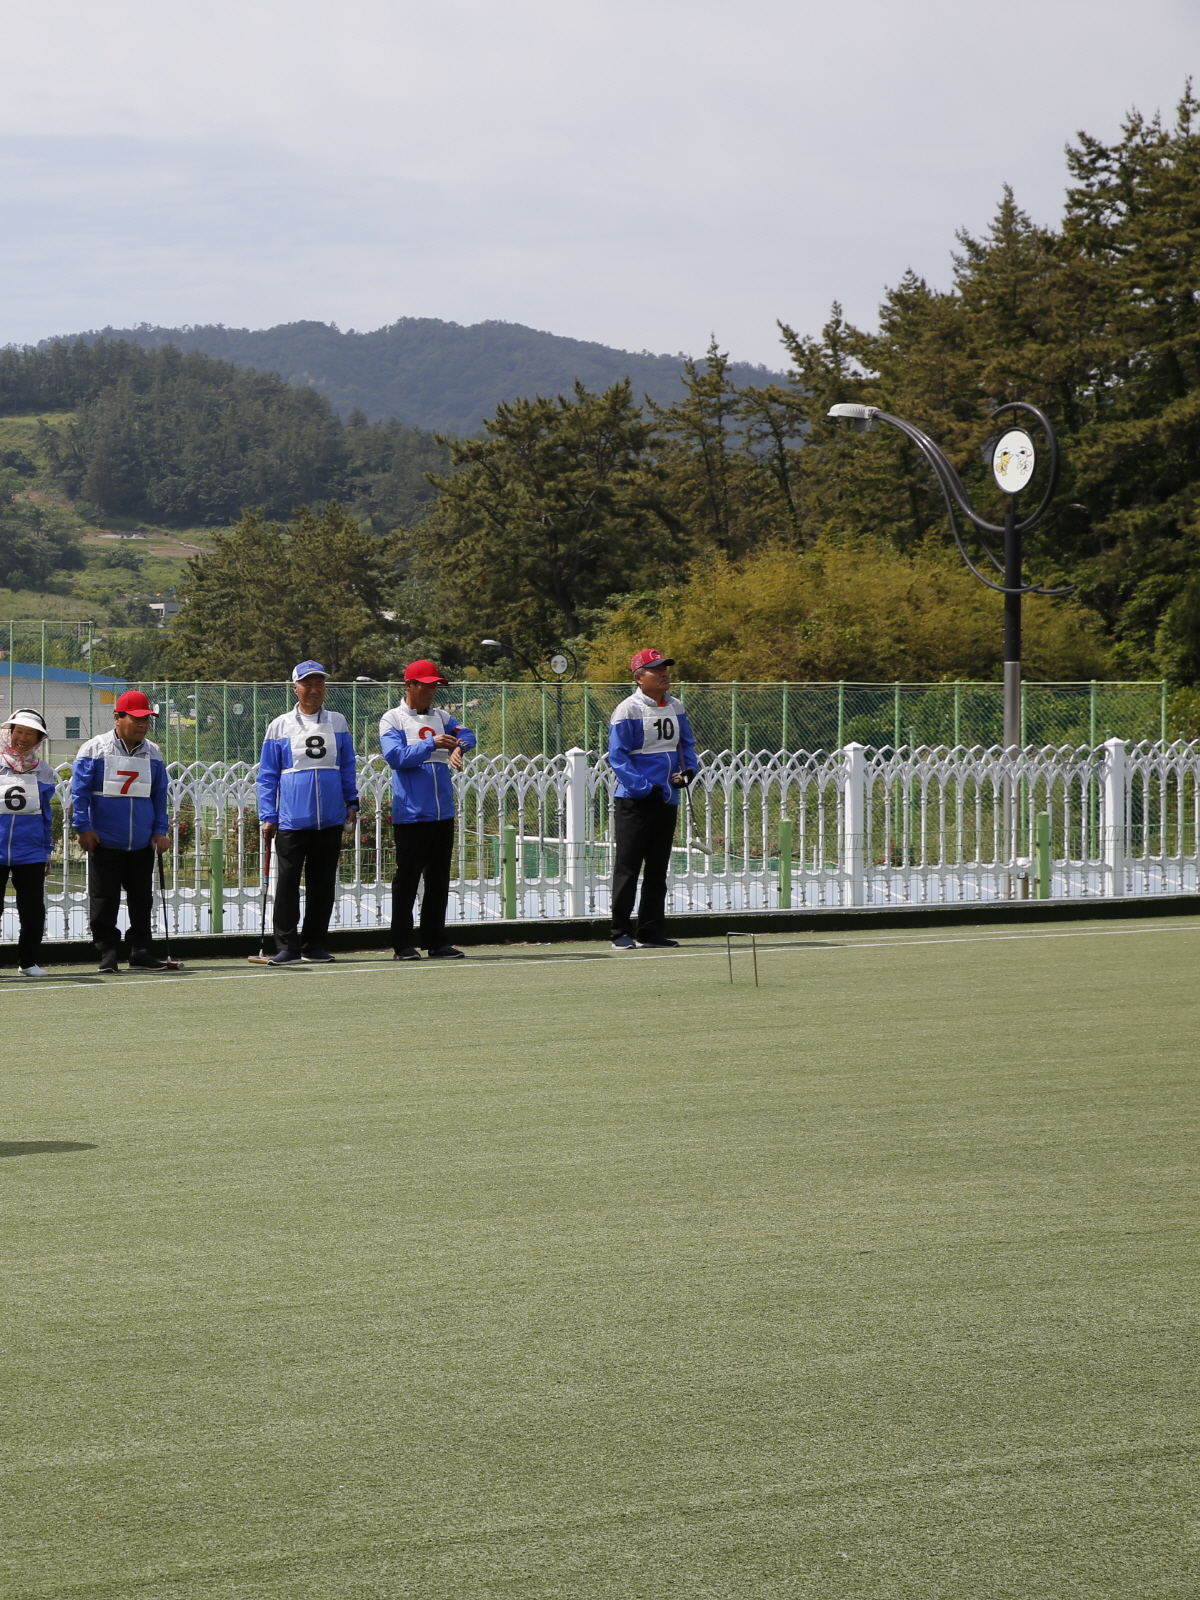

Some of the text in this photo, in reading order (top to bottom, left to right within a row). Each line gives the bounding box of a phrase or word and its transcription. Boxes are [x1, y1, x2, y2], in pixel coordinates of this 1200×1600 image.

[653, 718, 674, 740] 10
[305, 735, 327, 759] 8
[117, 770, 139, 795] 7
[4, 786, 27, 811] 6
